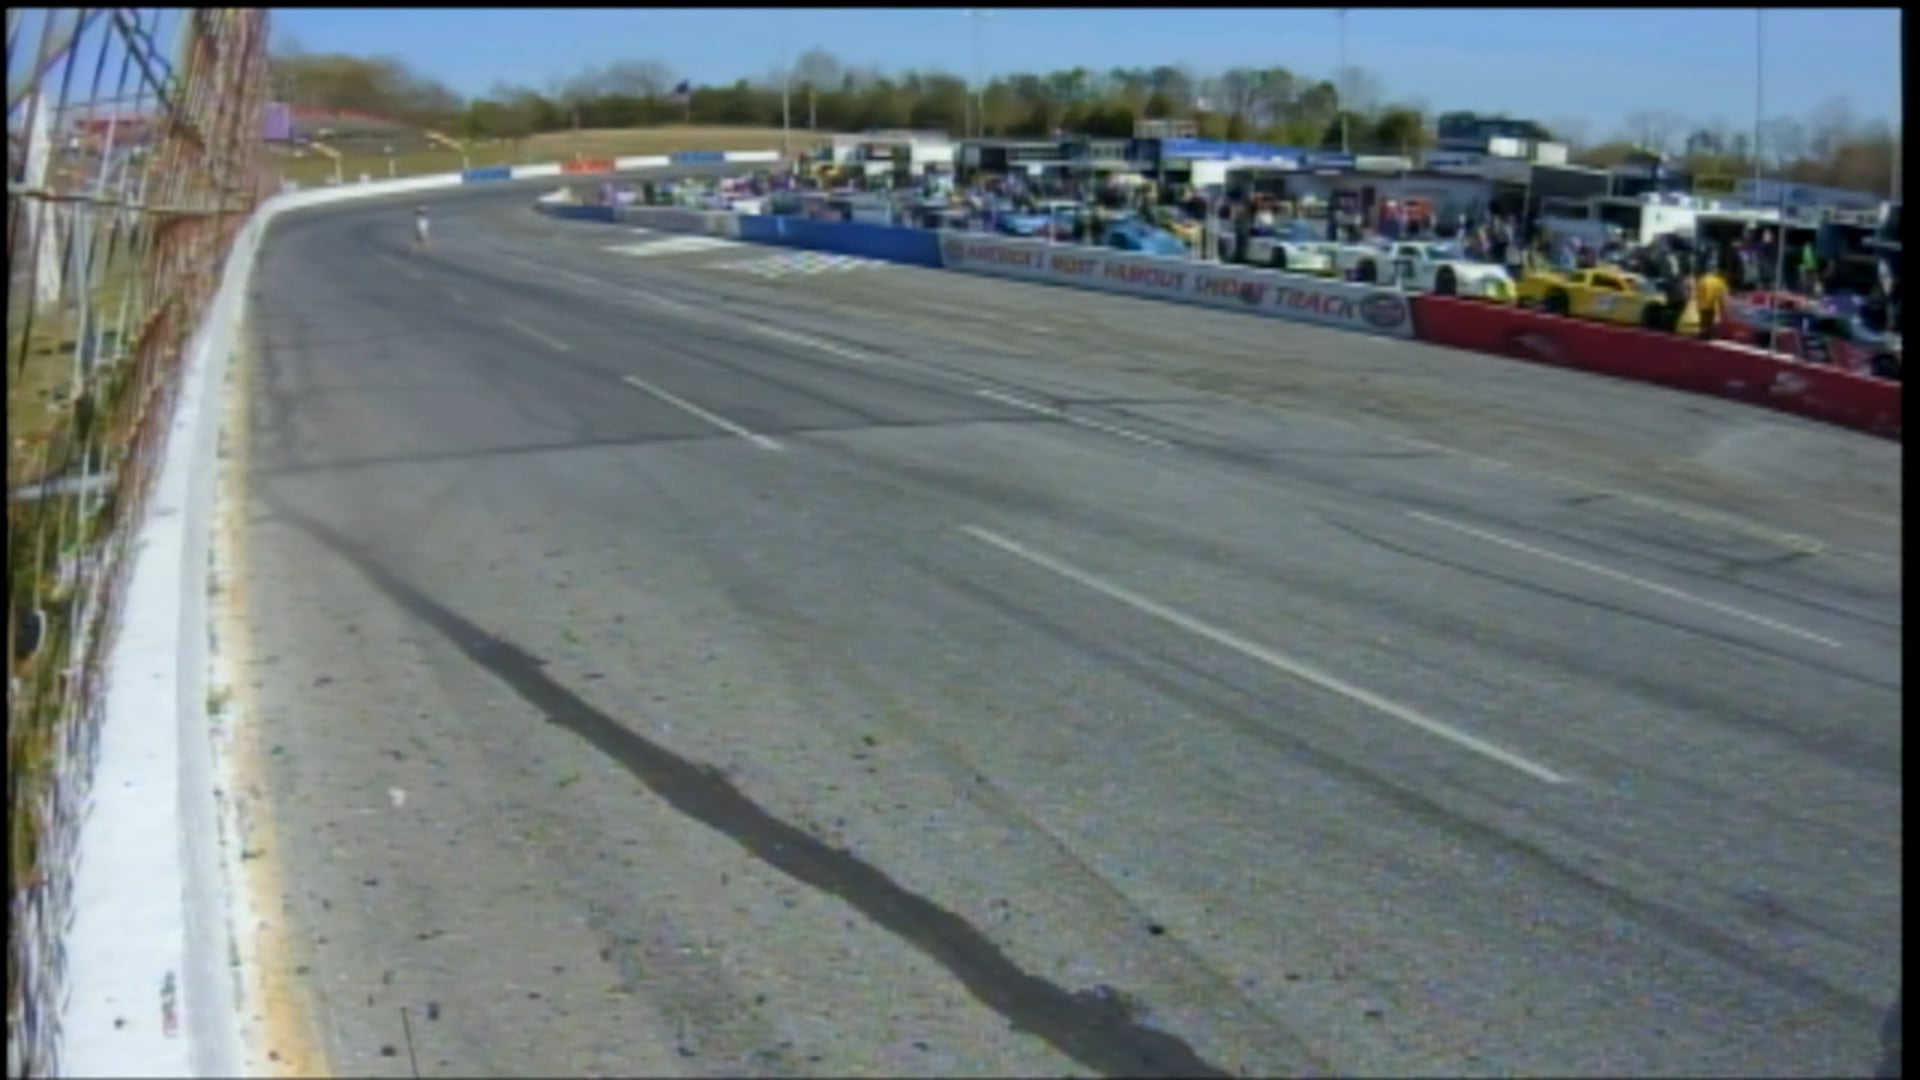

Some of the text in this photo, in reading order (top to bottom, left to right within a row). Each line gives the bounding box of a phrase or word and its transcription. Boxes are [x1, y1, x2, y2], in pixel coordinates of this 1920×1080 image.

[1049, 253, 1096, 275] MOST
[1103, 261, 1187, 291] FAMOUS
[1194, 275, 1268, 301] SHORT
[1274, 286, 1356, 319] TRACK
